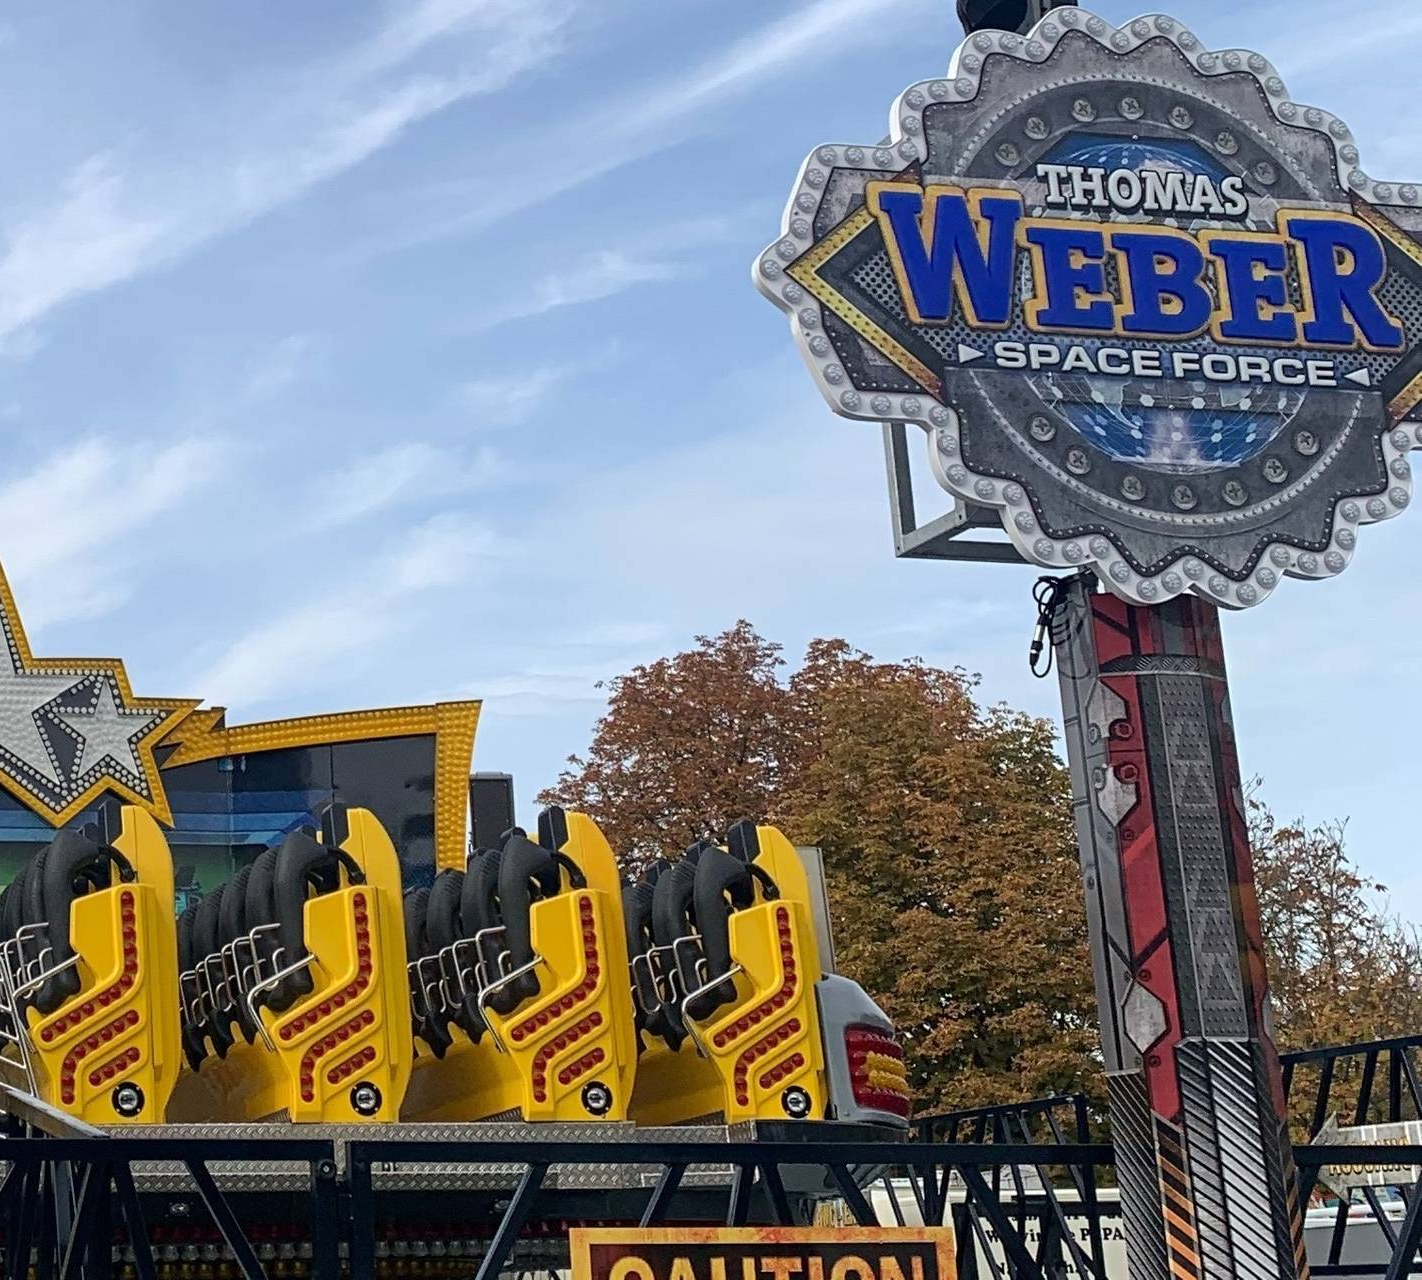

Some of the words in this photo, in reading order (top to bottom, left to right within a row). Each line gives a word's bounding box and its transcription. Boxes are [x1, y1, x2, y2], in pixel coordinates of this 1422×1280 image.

[1036, 163, 1249, 218] THOMAS
[879, 188, 1404, 350] WEBER
[996, 341, 1163, 379] SPACE
[1173, 350, 1335, 388] FORCE
